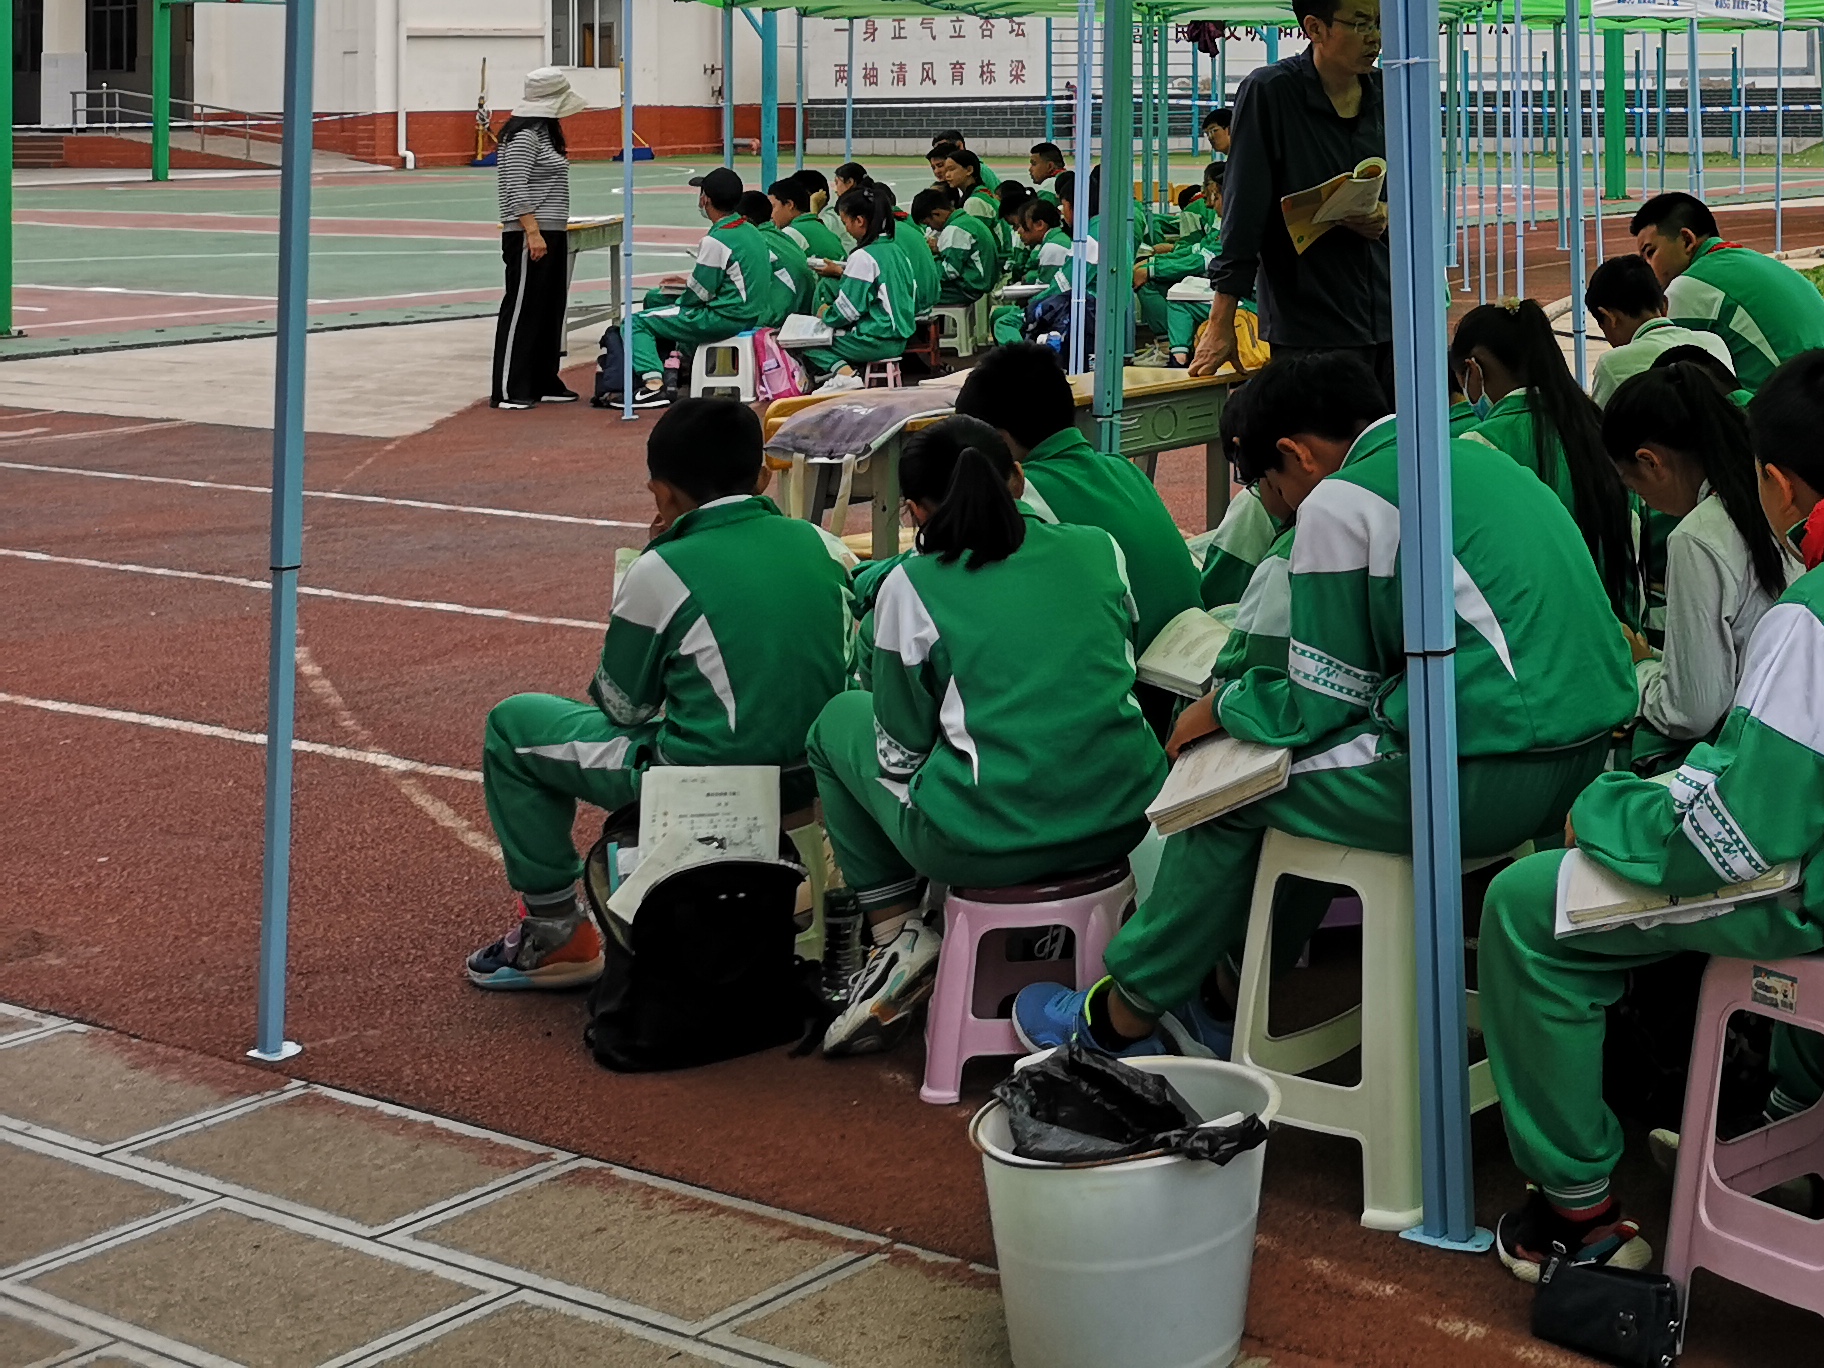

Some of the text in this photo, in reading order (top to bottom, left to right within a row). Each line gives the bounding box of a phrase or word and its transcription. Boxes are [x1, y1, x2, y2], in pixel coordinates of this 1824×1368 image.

[834, 59, 1026, 87] 两袖清风育栋梁
